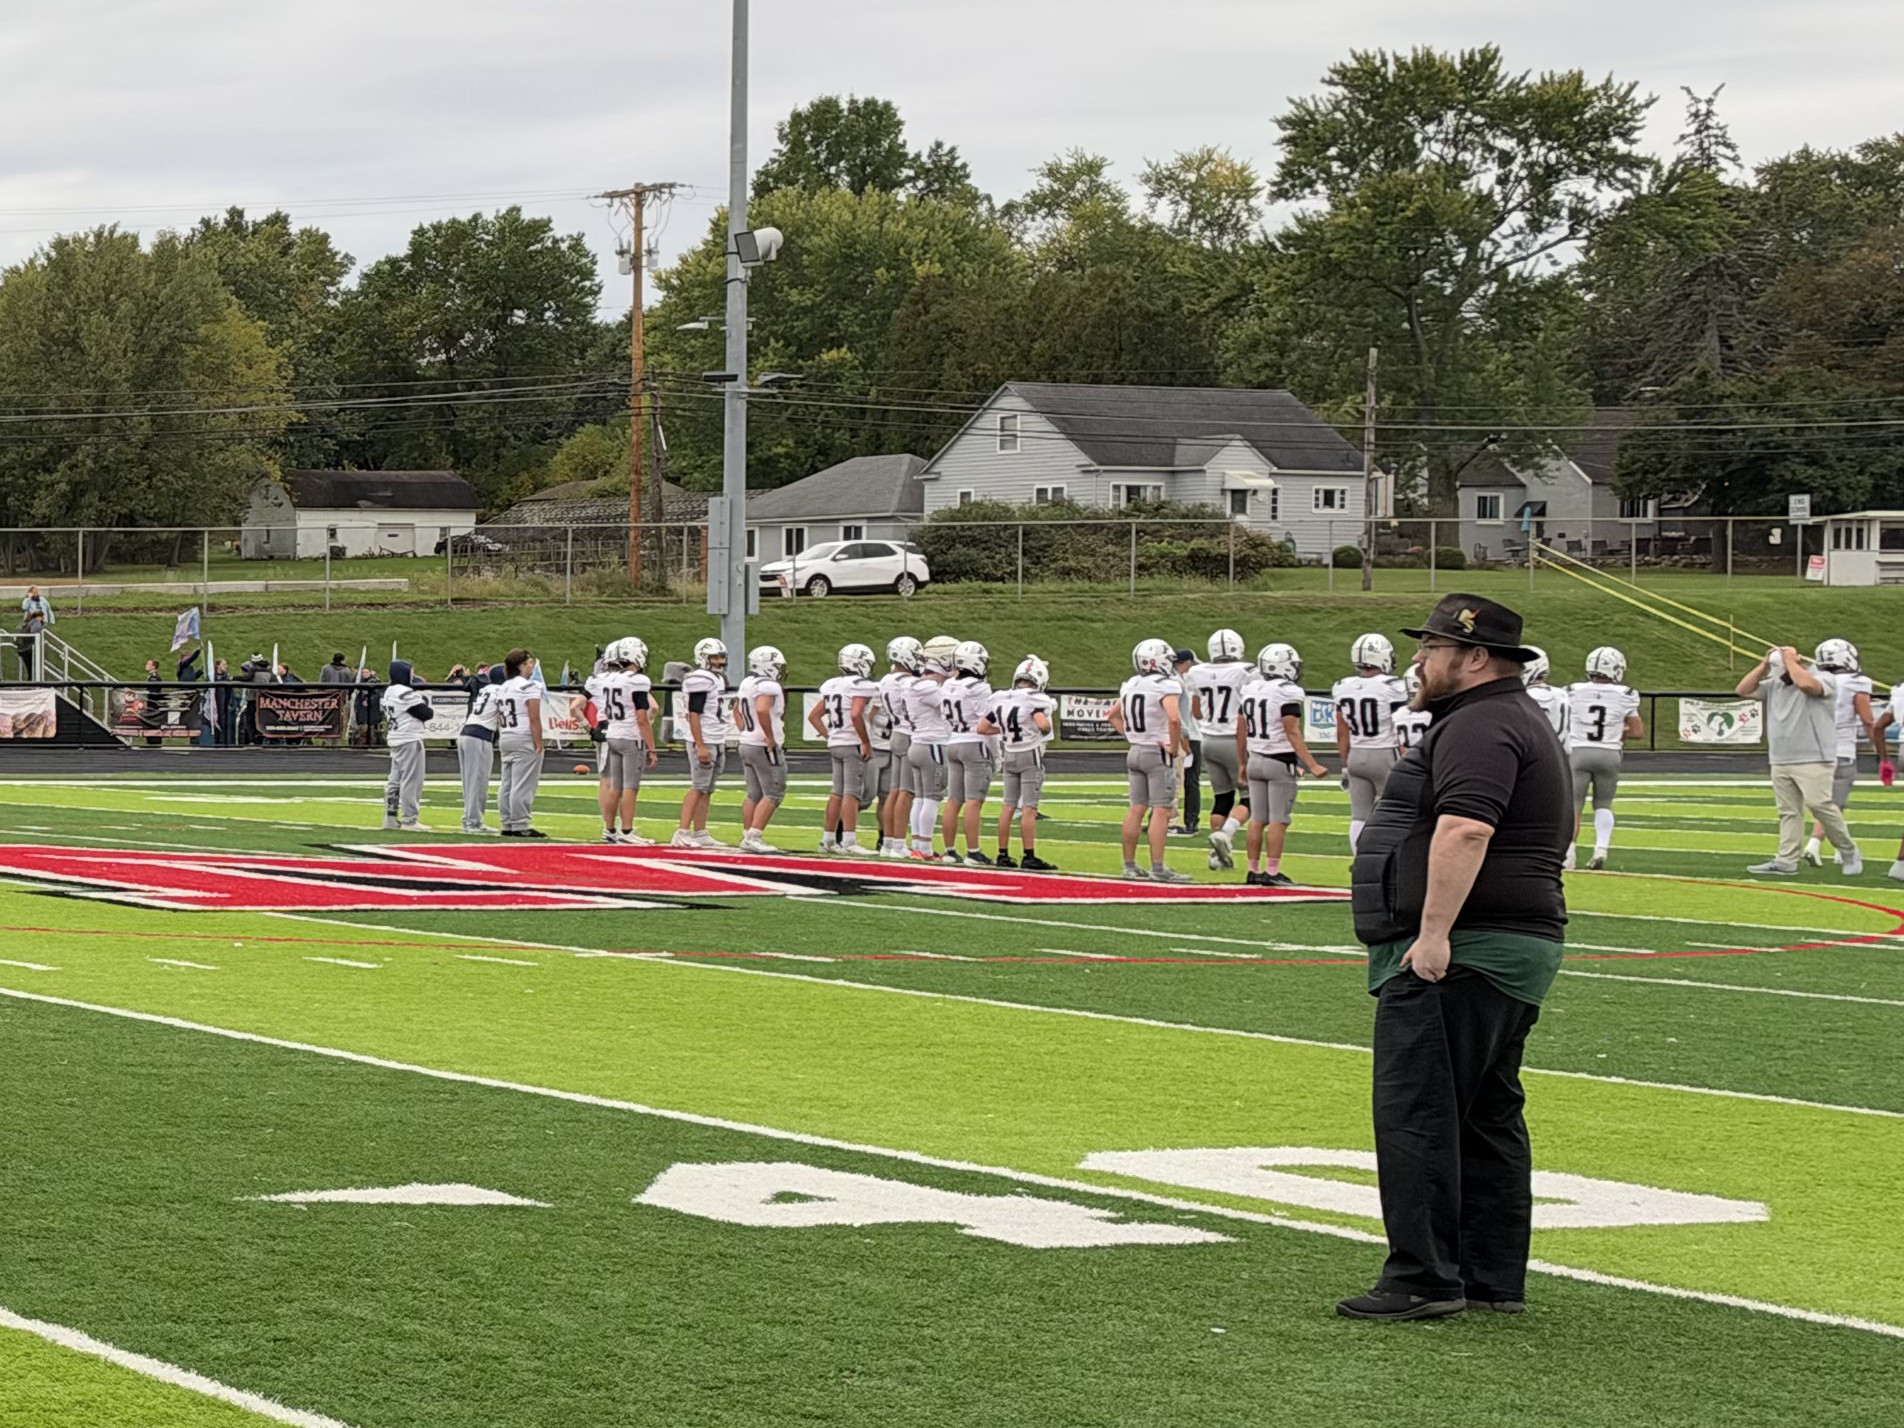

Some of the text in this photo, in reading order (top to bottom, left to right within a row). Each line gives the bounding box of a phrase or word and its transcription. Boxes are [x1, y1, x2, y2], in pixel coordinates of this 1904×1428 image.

[259, 697, 339, 709] MANCHESTER
[276, 709, 323, 722] TAVERN
[1122, 693, 1146, 732] 10
[1339, 697, 1379, 737] 30
[1587, 705, 1607, 742] 3
